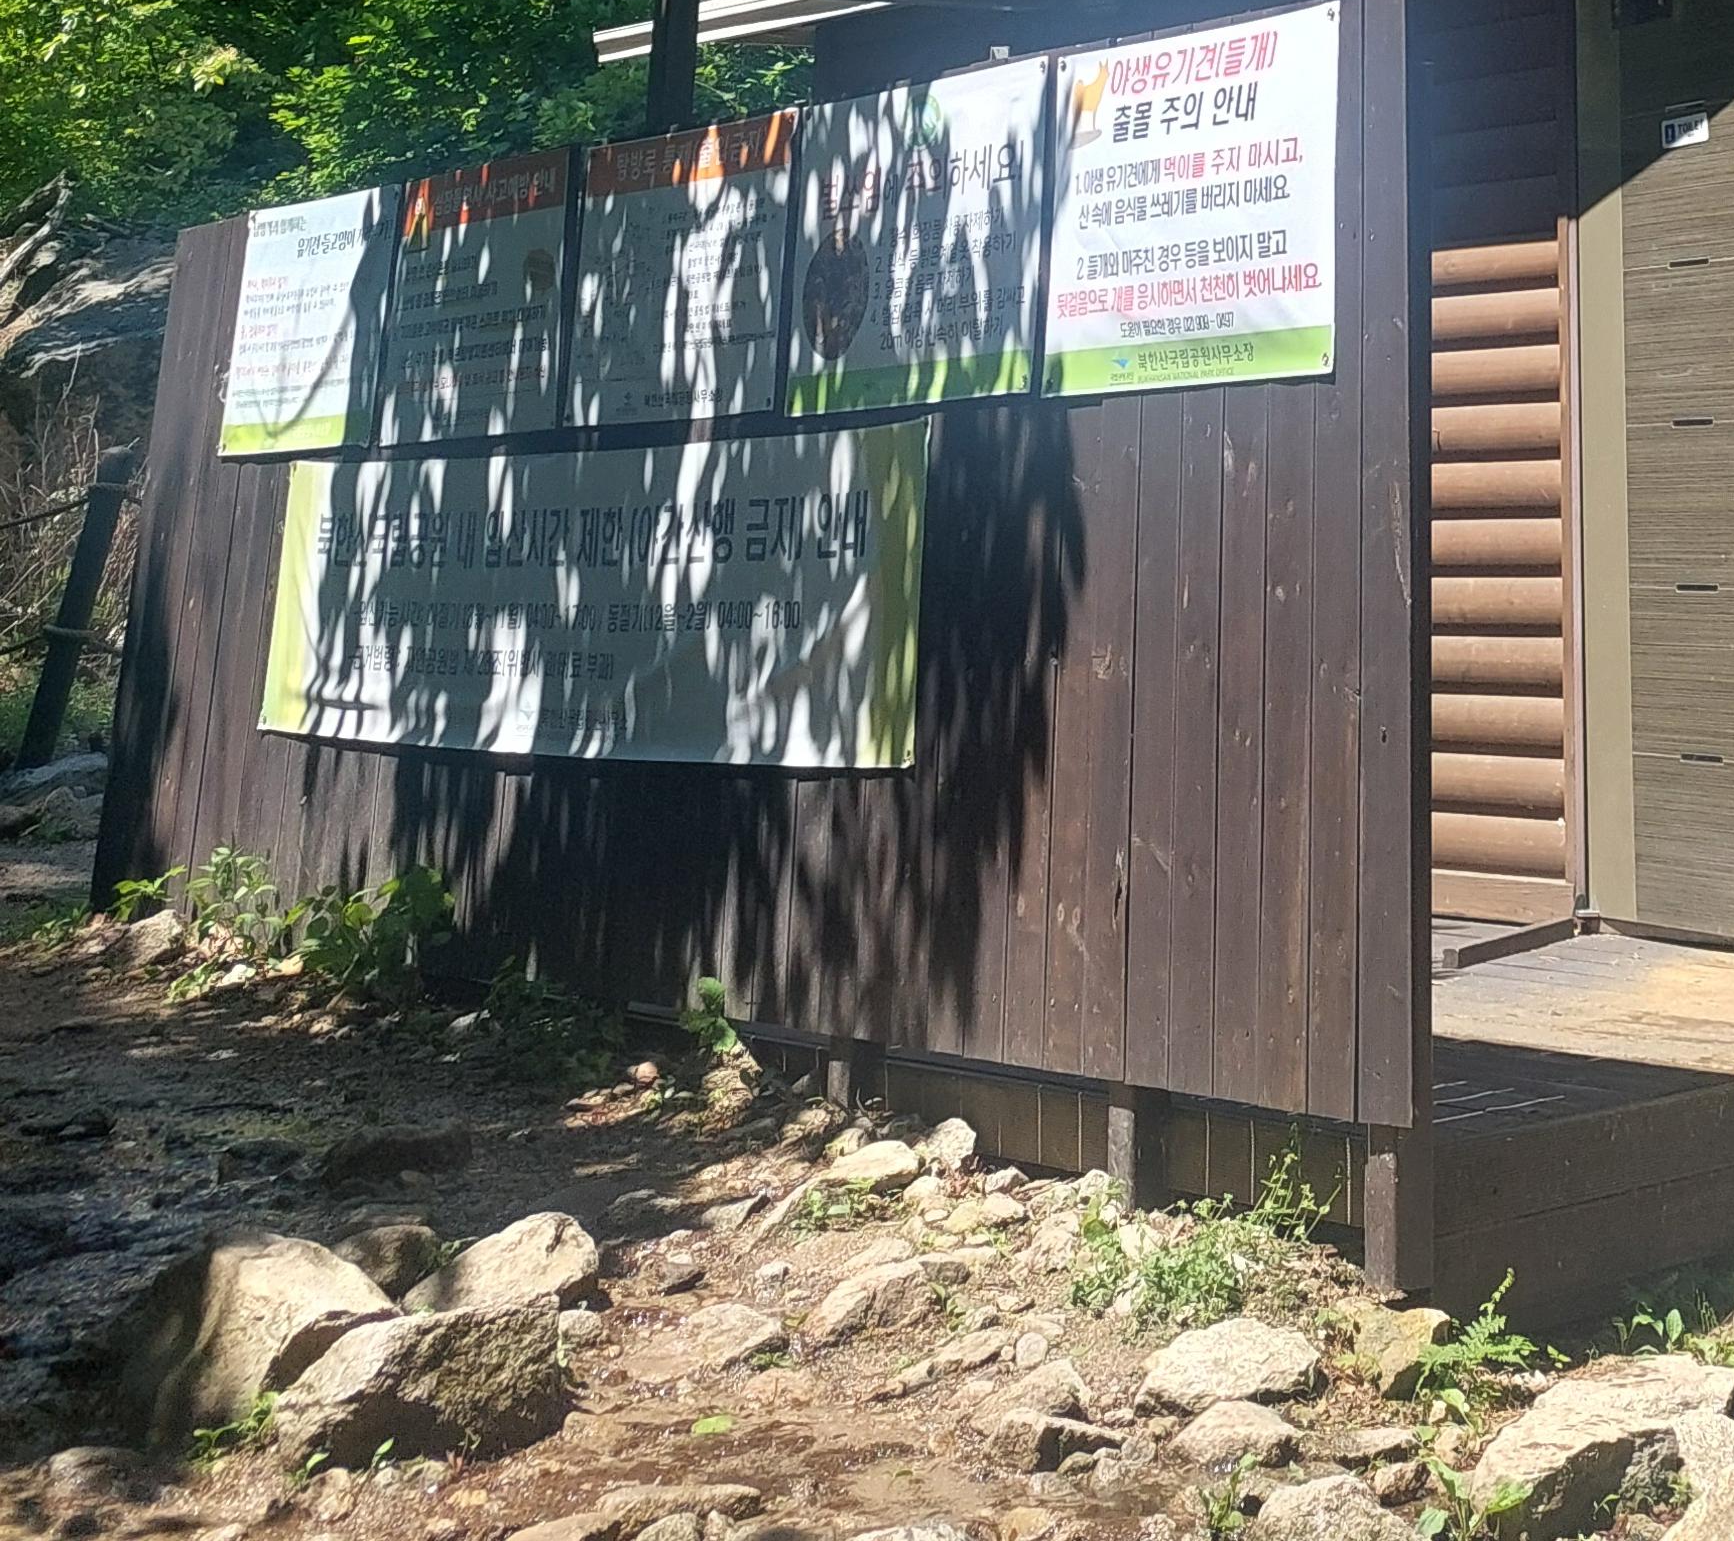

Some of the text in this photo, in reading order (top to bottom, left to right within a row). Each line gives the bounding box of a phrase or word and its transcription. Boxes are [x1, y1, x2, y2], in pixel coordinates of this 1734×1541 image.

[1110, 30, 1279, 95] 야생유기견(들개)
[1112, 81, 1258, 143] 출몰 주의 안내
[1106, 158, 1161, 192] 유기견에게
[1163, 152, 1206, 182] 먹이를
[1211, 146, 1241, 175] 주지
[1248, 137, 1303, 168] 마시고,
[1114, 195, 1148, 225] 음식물
[1149, 187, 1198, 219] 쓰레기를
[1201, 180, 1240, 211] 버리지
[1087, 251, 1119, 280] 들개와
[1122, 245, 1155, 276] 마주친
[1158, 243, 1181, 274] 경우
[1184, 239, 1209, 269] 등을
[1213, 233, 1252, 264] 보이지
[1257, 229, 1288, 258] 말고
[1058, 288, 1109, 318] 뒷걸음으로
[1111, 284, 1134, 313] 개를
[1137, 277, 1197, 310] 응시하면서
[1200, 271, 1239, 303] 천천히
[1137, 342, 1254, 372] 북한산국립공원사무소장
[816, 489, 870, 560] 안내
